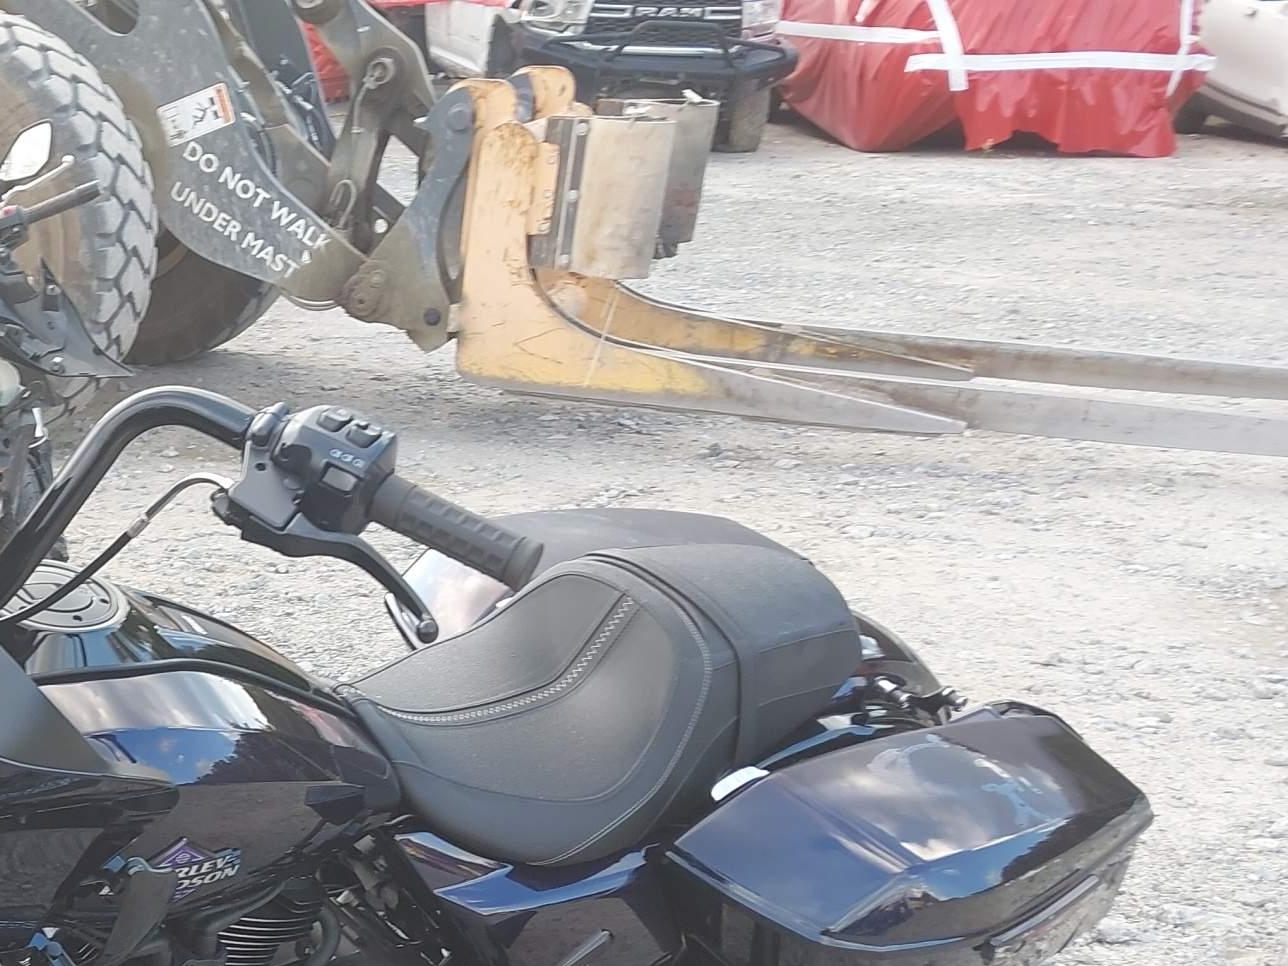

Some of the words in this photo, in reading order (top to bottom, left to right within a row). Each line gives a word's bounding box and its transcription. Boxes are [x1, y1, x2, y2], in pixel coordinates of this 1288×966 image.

[635, 7, 704, 18] RAM
[170, 181, 242, 241] UNDER
[241, 232, 300, 278] MAST
[182, 141, 219, 173] DO
[218, 166, 271, 208] NOT
[270, 201, 332, 250] WALK
